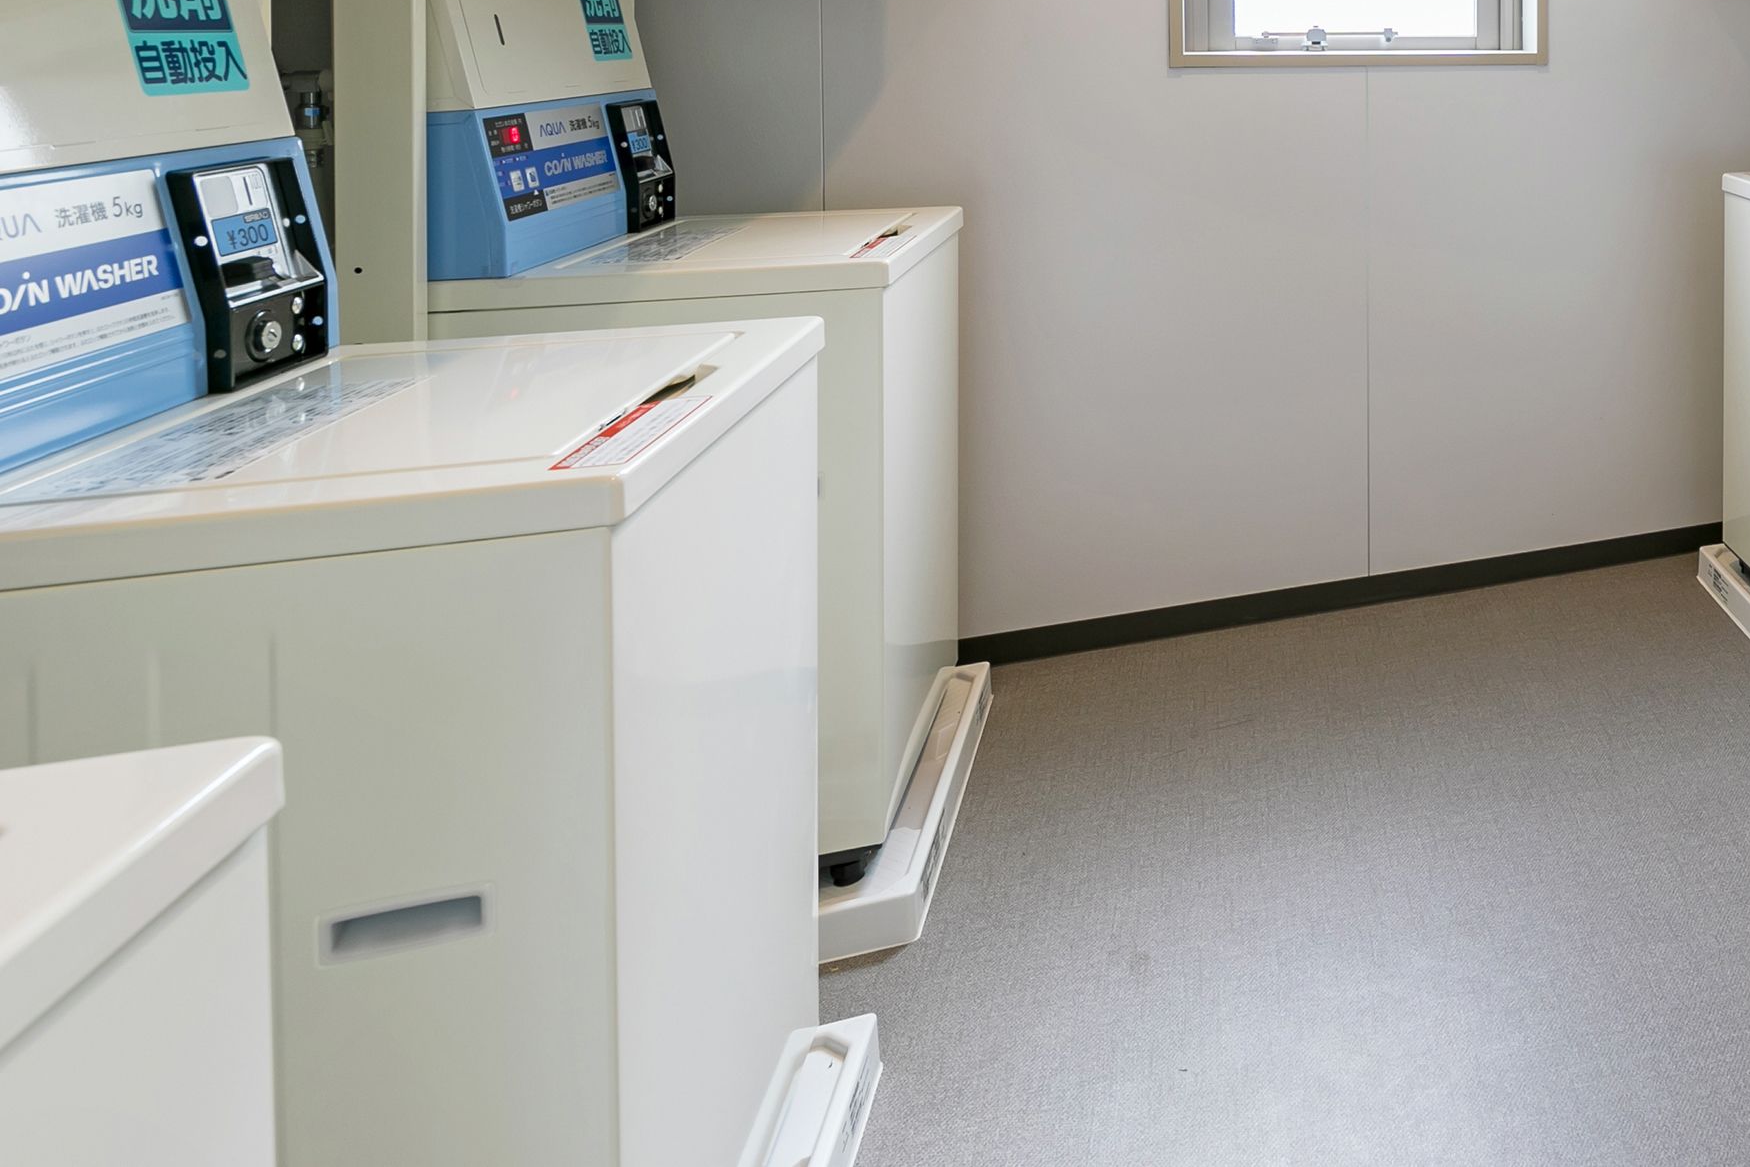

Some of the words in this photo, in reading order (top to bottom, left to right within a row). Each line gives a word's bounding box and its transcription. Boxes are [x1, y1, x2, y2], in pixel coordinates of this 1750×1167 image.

[589, 28, 633, 56] 自動投入
[135, 40, 248, 86] 自動投入
[540, 121, 566, 138] AQUA
[588, 115, 600, 129] 5kg
[571, 150, 608, 171] WASHER
[55, 202, 109, 229] 洗濯機
[112, 196, 144, 219] 5kg
[227, 223, 269, 250] ¥300
[55, 255, 159, 299] WASHER
